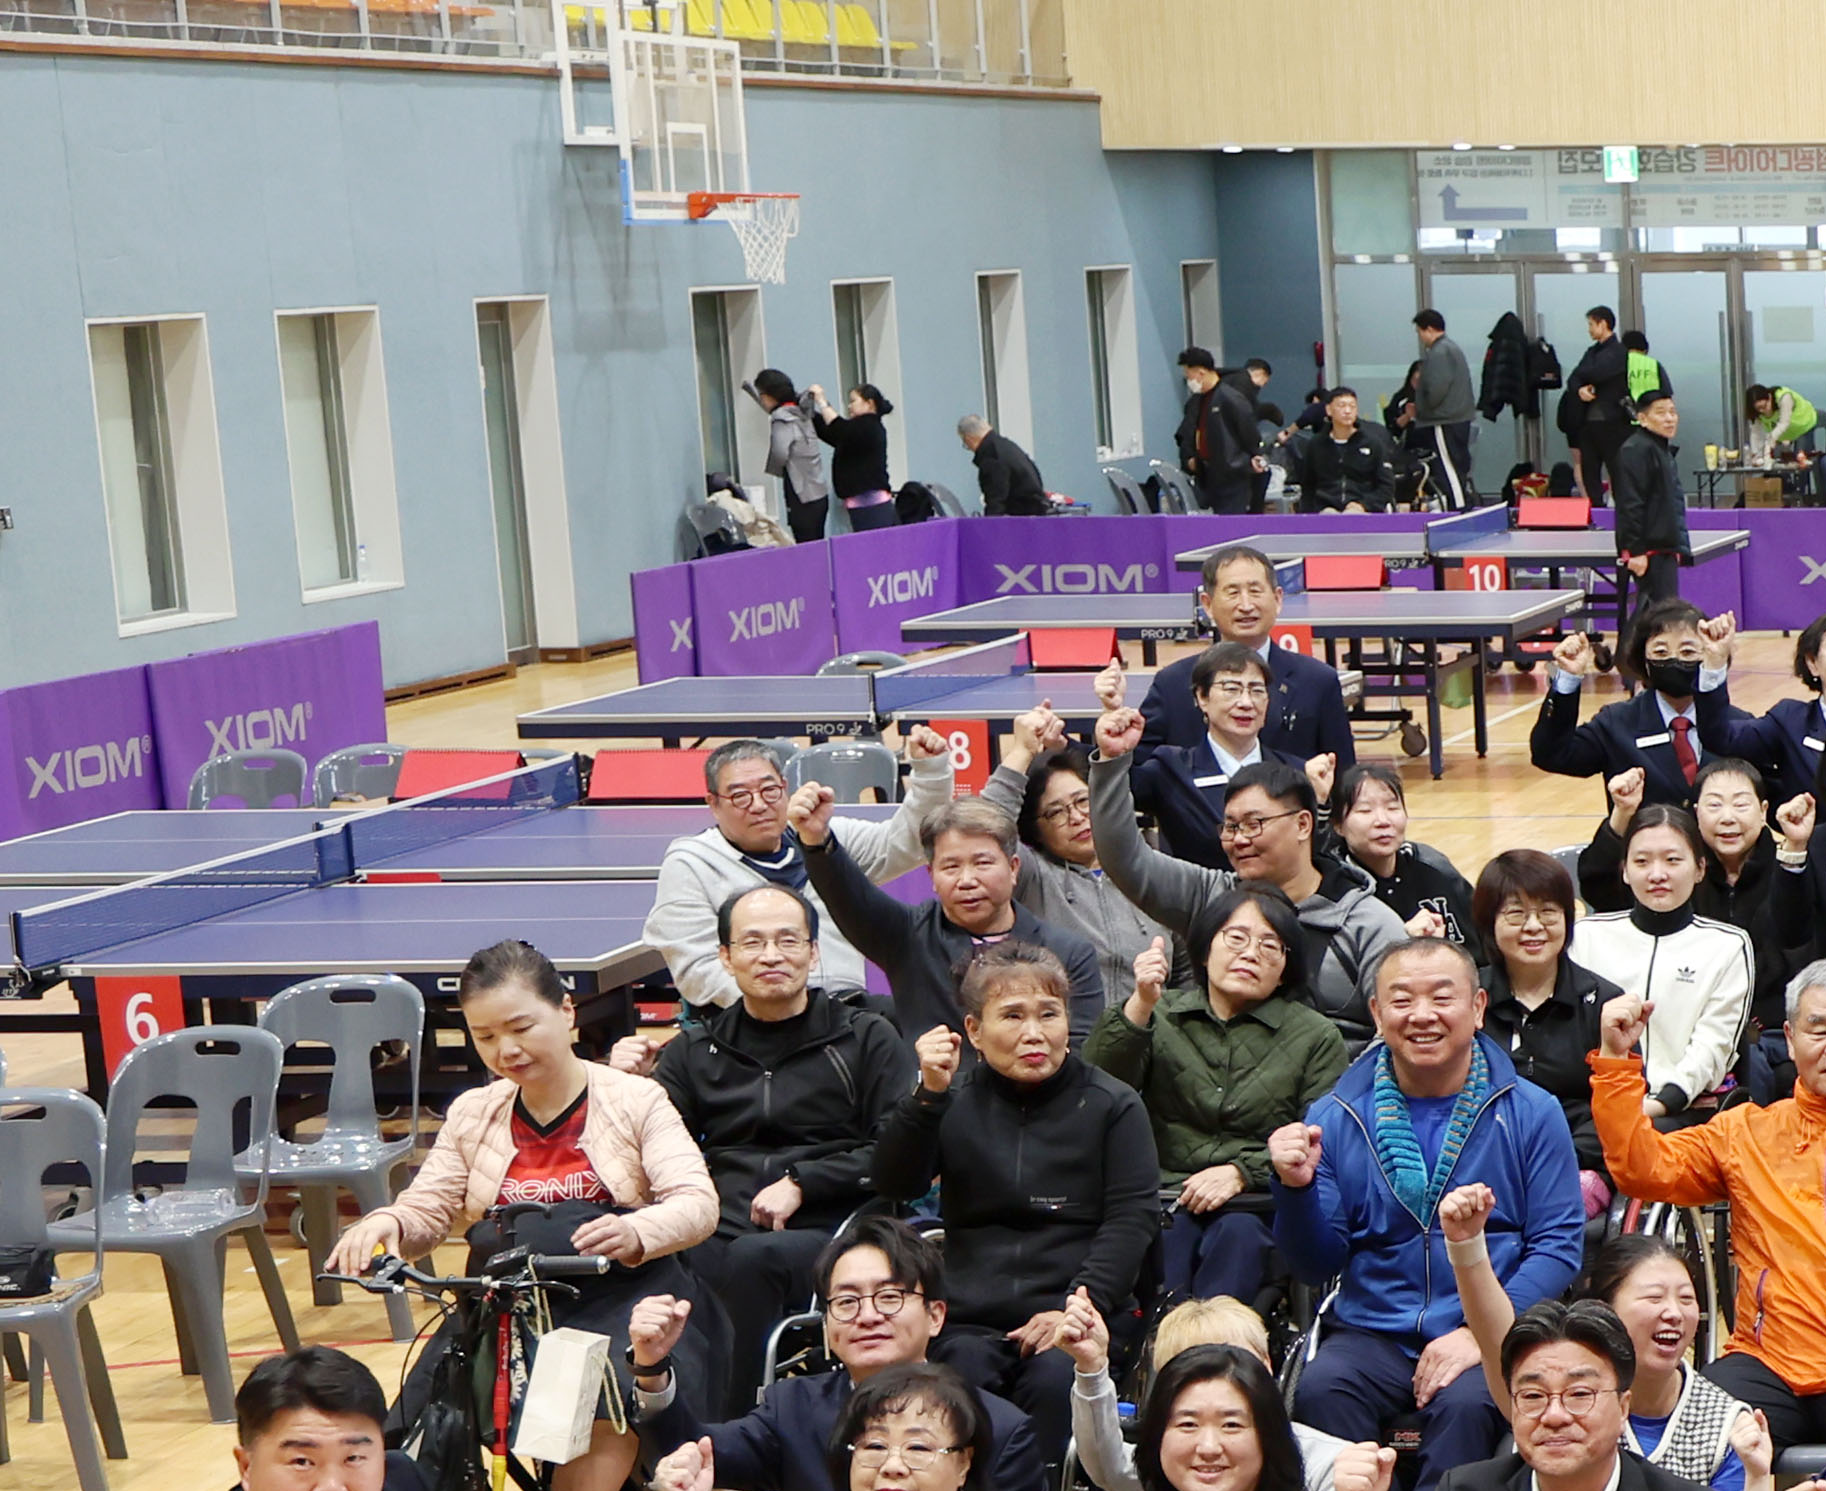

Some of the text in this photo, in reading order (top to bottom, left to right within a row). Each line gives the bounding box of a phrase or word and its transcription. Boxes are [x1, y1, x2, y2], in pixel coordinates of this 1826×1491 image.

[1468, 563, 1501, 590] 10
[1141, 629, 1165, 640] PRO
[806, 724, 835, 736] PRO
[947, 730, 971, 770] 8
[125, 992, 160, 1045] 6
